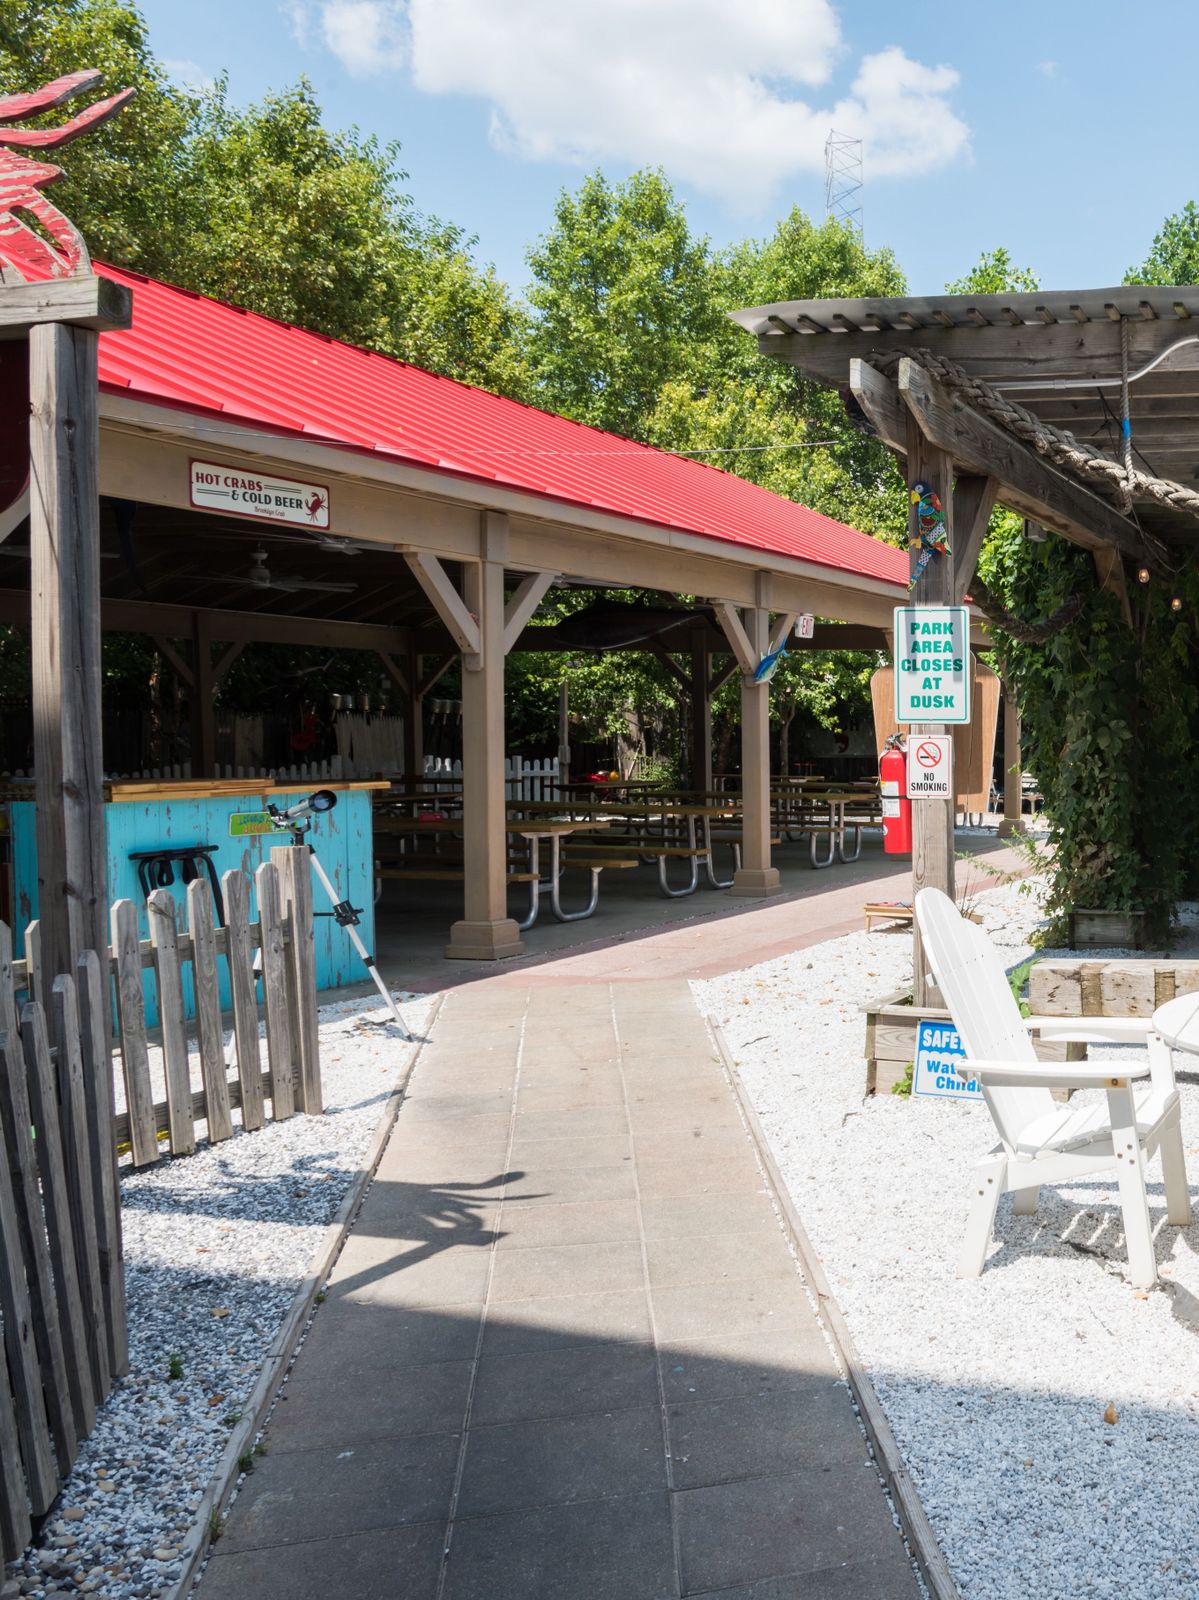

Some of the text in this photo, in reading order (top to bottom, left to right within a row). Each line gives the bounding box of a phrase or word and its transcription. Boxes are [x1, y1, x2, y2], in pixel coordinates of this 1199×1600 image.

[195, 471, 263, 492] HOT CRABS
[231, 489, 303, 510] & COLD BEER
[910, 622, 954, 635] PARK
[911, 640, 953, 653] AREA
[901, 658, 963, 672] CLOSES
[922, 677, 942, 690] AT
[910, 695, 955, 708] DUSK
[923, 772, 935, 782] NO
[910, 782, 948, 792] SMOKING
[922, 1028, 964, 1050] SAFE
